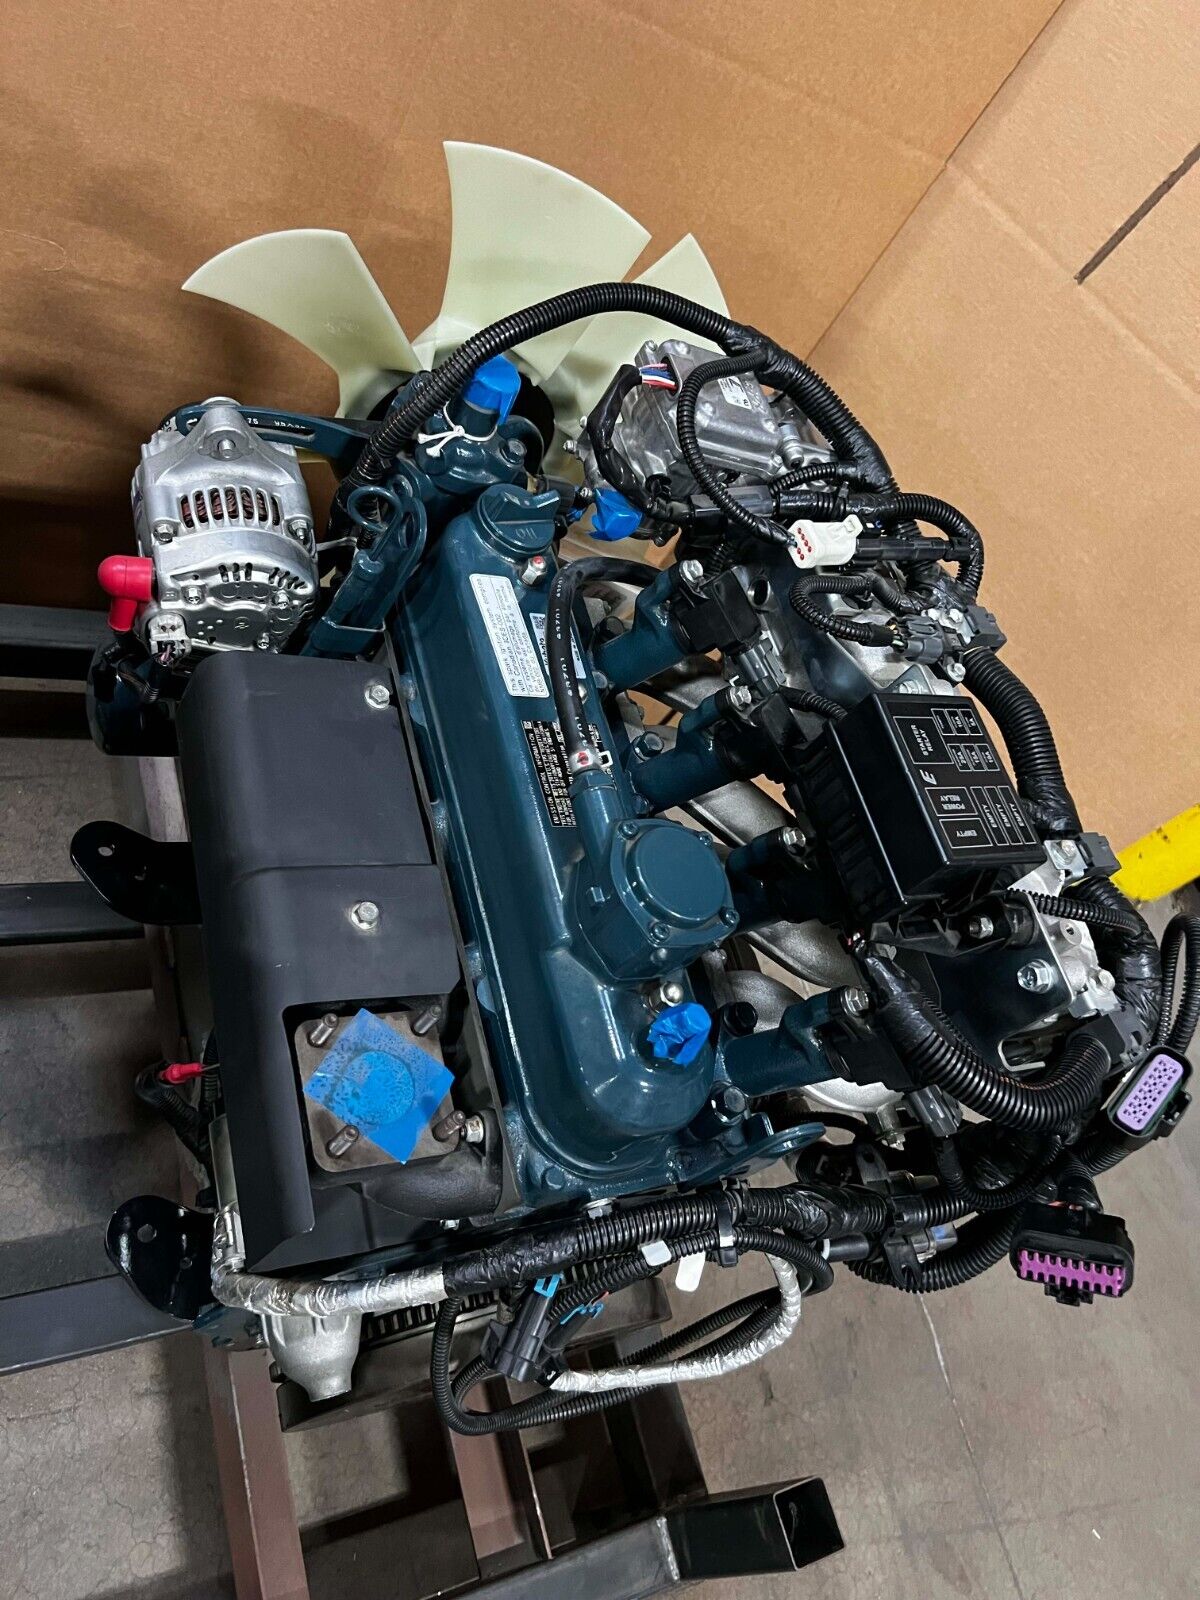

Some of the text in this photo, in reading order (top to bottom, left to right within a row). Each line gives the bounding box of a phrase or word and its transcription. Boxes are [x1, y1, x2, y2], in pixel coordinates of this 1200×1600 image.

[506, 646, 520, 675] Canadian
[911, 724, 929, 755] STARTER
[919, 729, 933, 751] RELAY
[982, 804, 997, 827] EMPTY
[996, 803, 1011, 827] EMPTY
[1011, 803, 1024, 826] EMPTY
